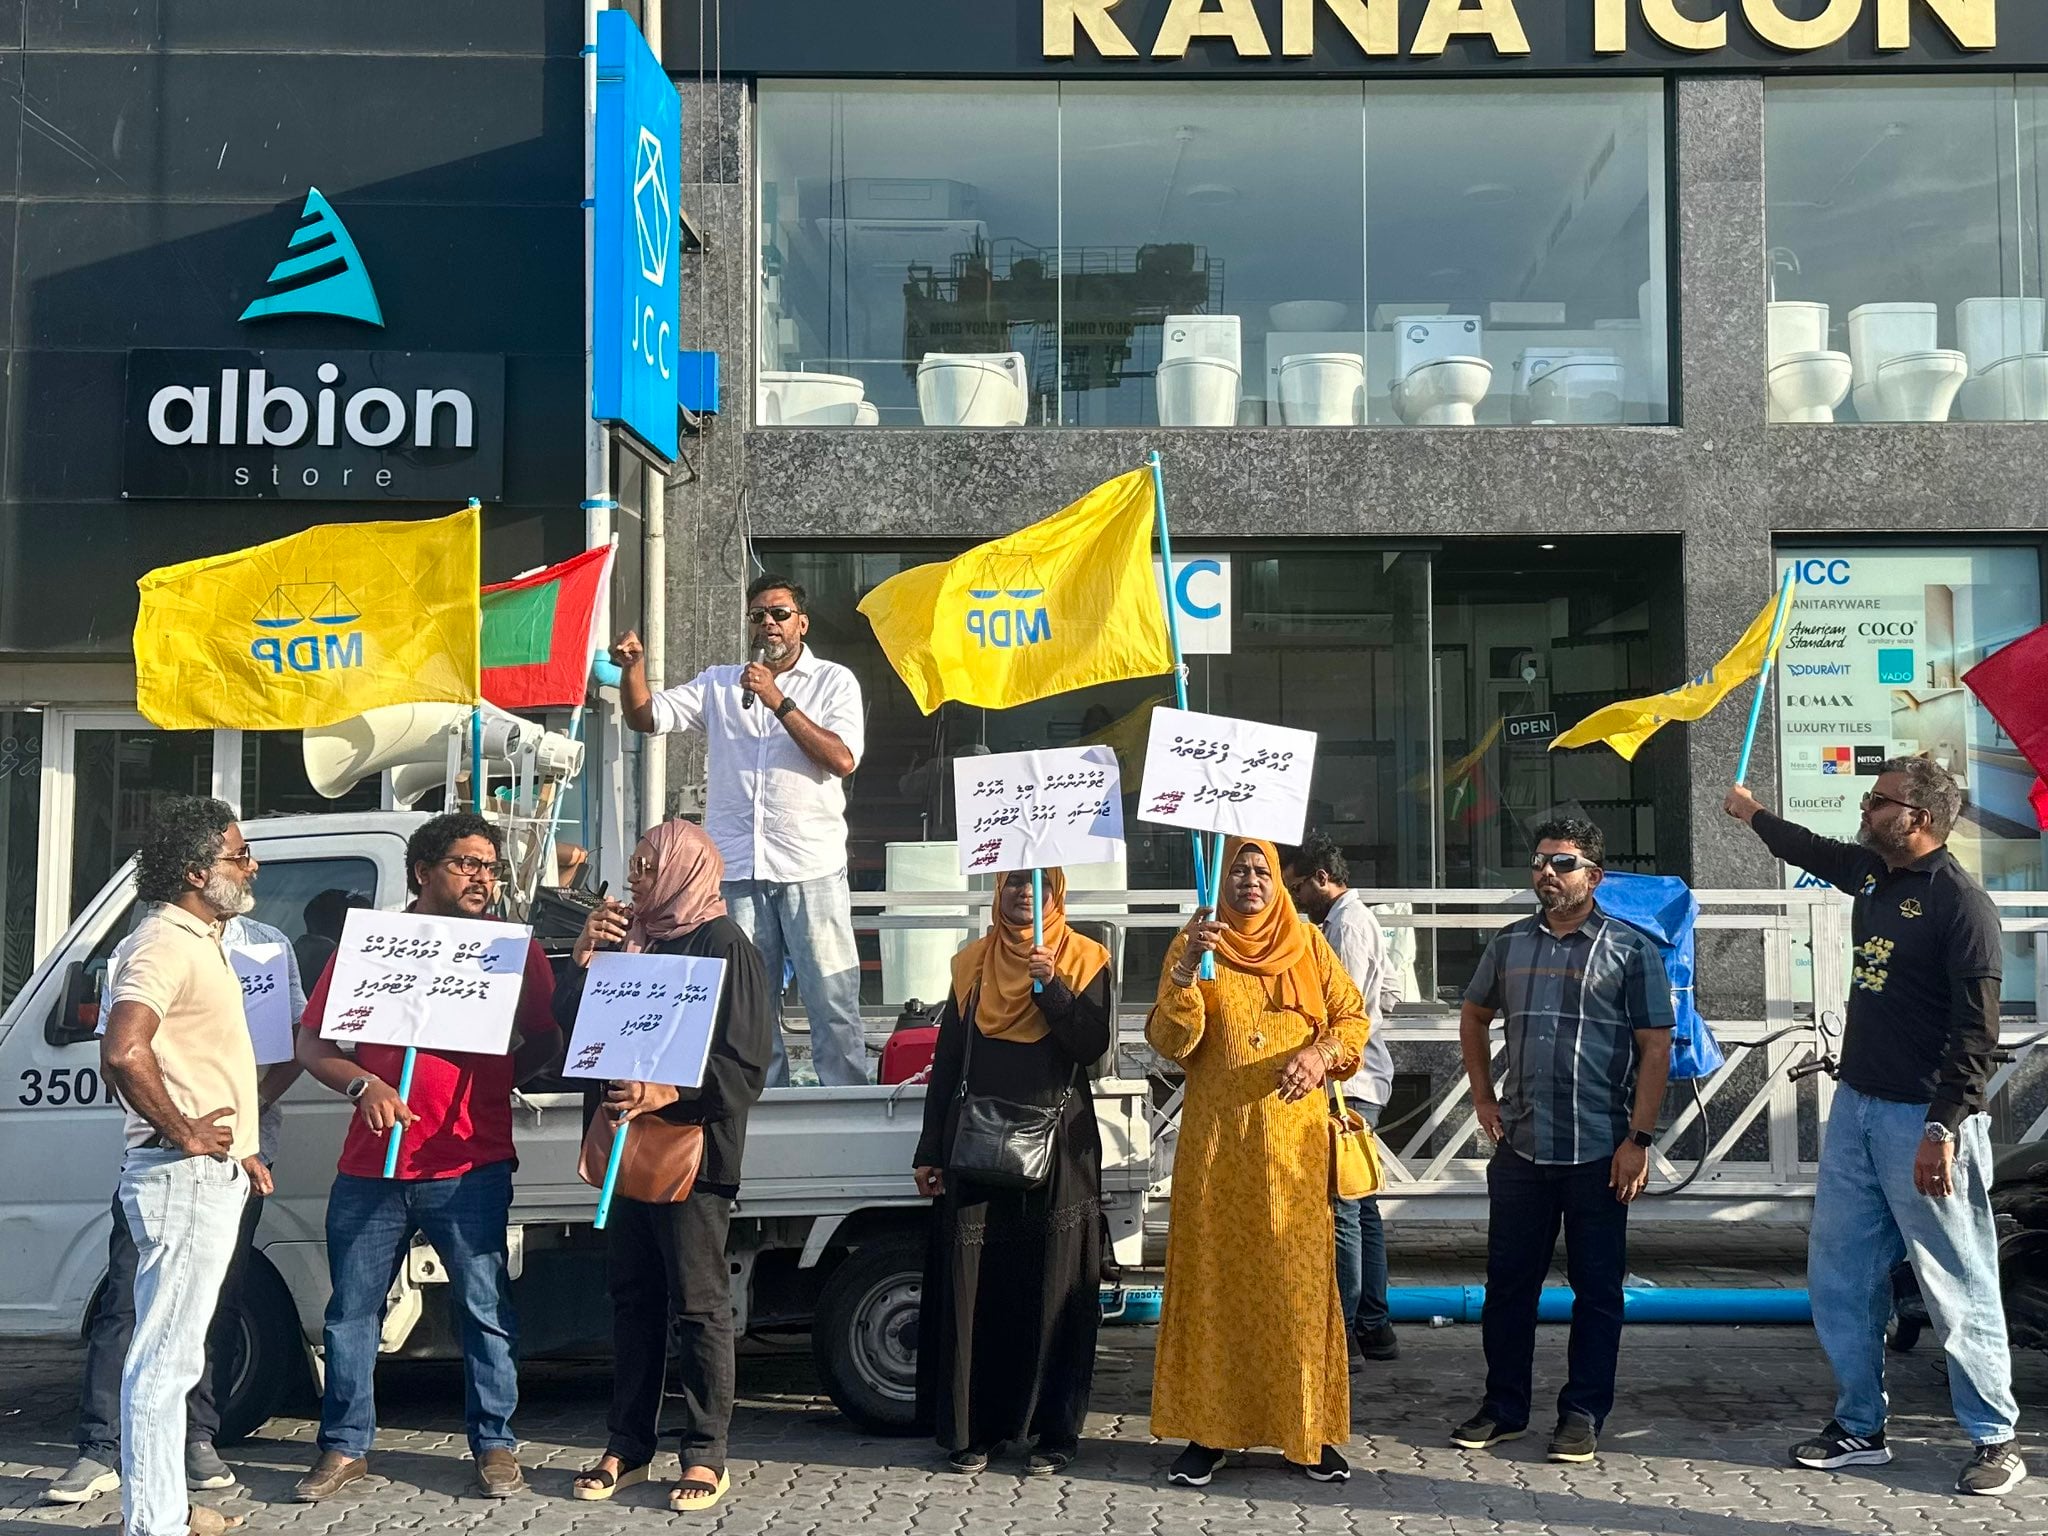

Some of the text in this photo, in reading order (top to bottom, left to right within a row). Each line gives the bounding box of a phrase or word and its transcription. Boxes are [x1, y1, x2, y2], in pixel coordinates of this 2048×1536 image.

[1042, 0, 1997, 58] RANA ICON
[632, 294, 670, 381] JCC
[147, 362, 474, 447] albion
[234, 464, 393, 488] store
[1791, 599, 1881, 609] ANITARYWARE
[1788, 620, 1846, 636] American
[1785, 635, 1847, 649] Standard
[1804, 661, 1851, 676] DURAVIT
[1881, 672, 1912, 681] VADO
[1786, 694, 1854, 707] ROMAX
[1509, 719, 1551, 736] OPEN
[1787, 723, 1872, 734] LUXURY TILES
[1857, 755, 1882, 763] NITCO
[1789, 796, 1842, 808] Guocera
